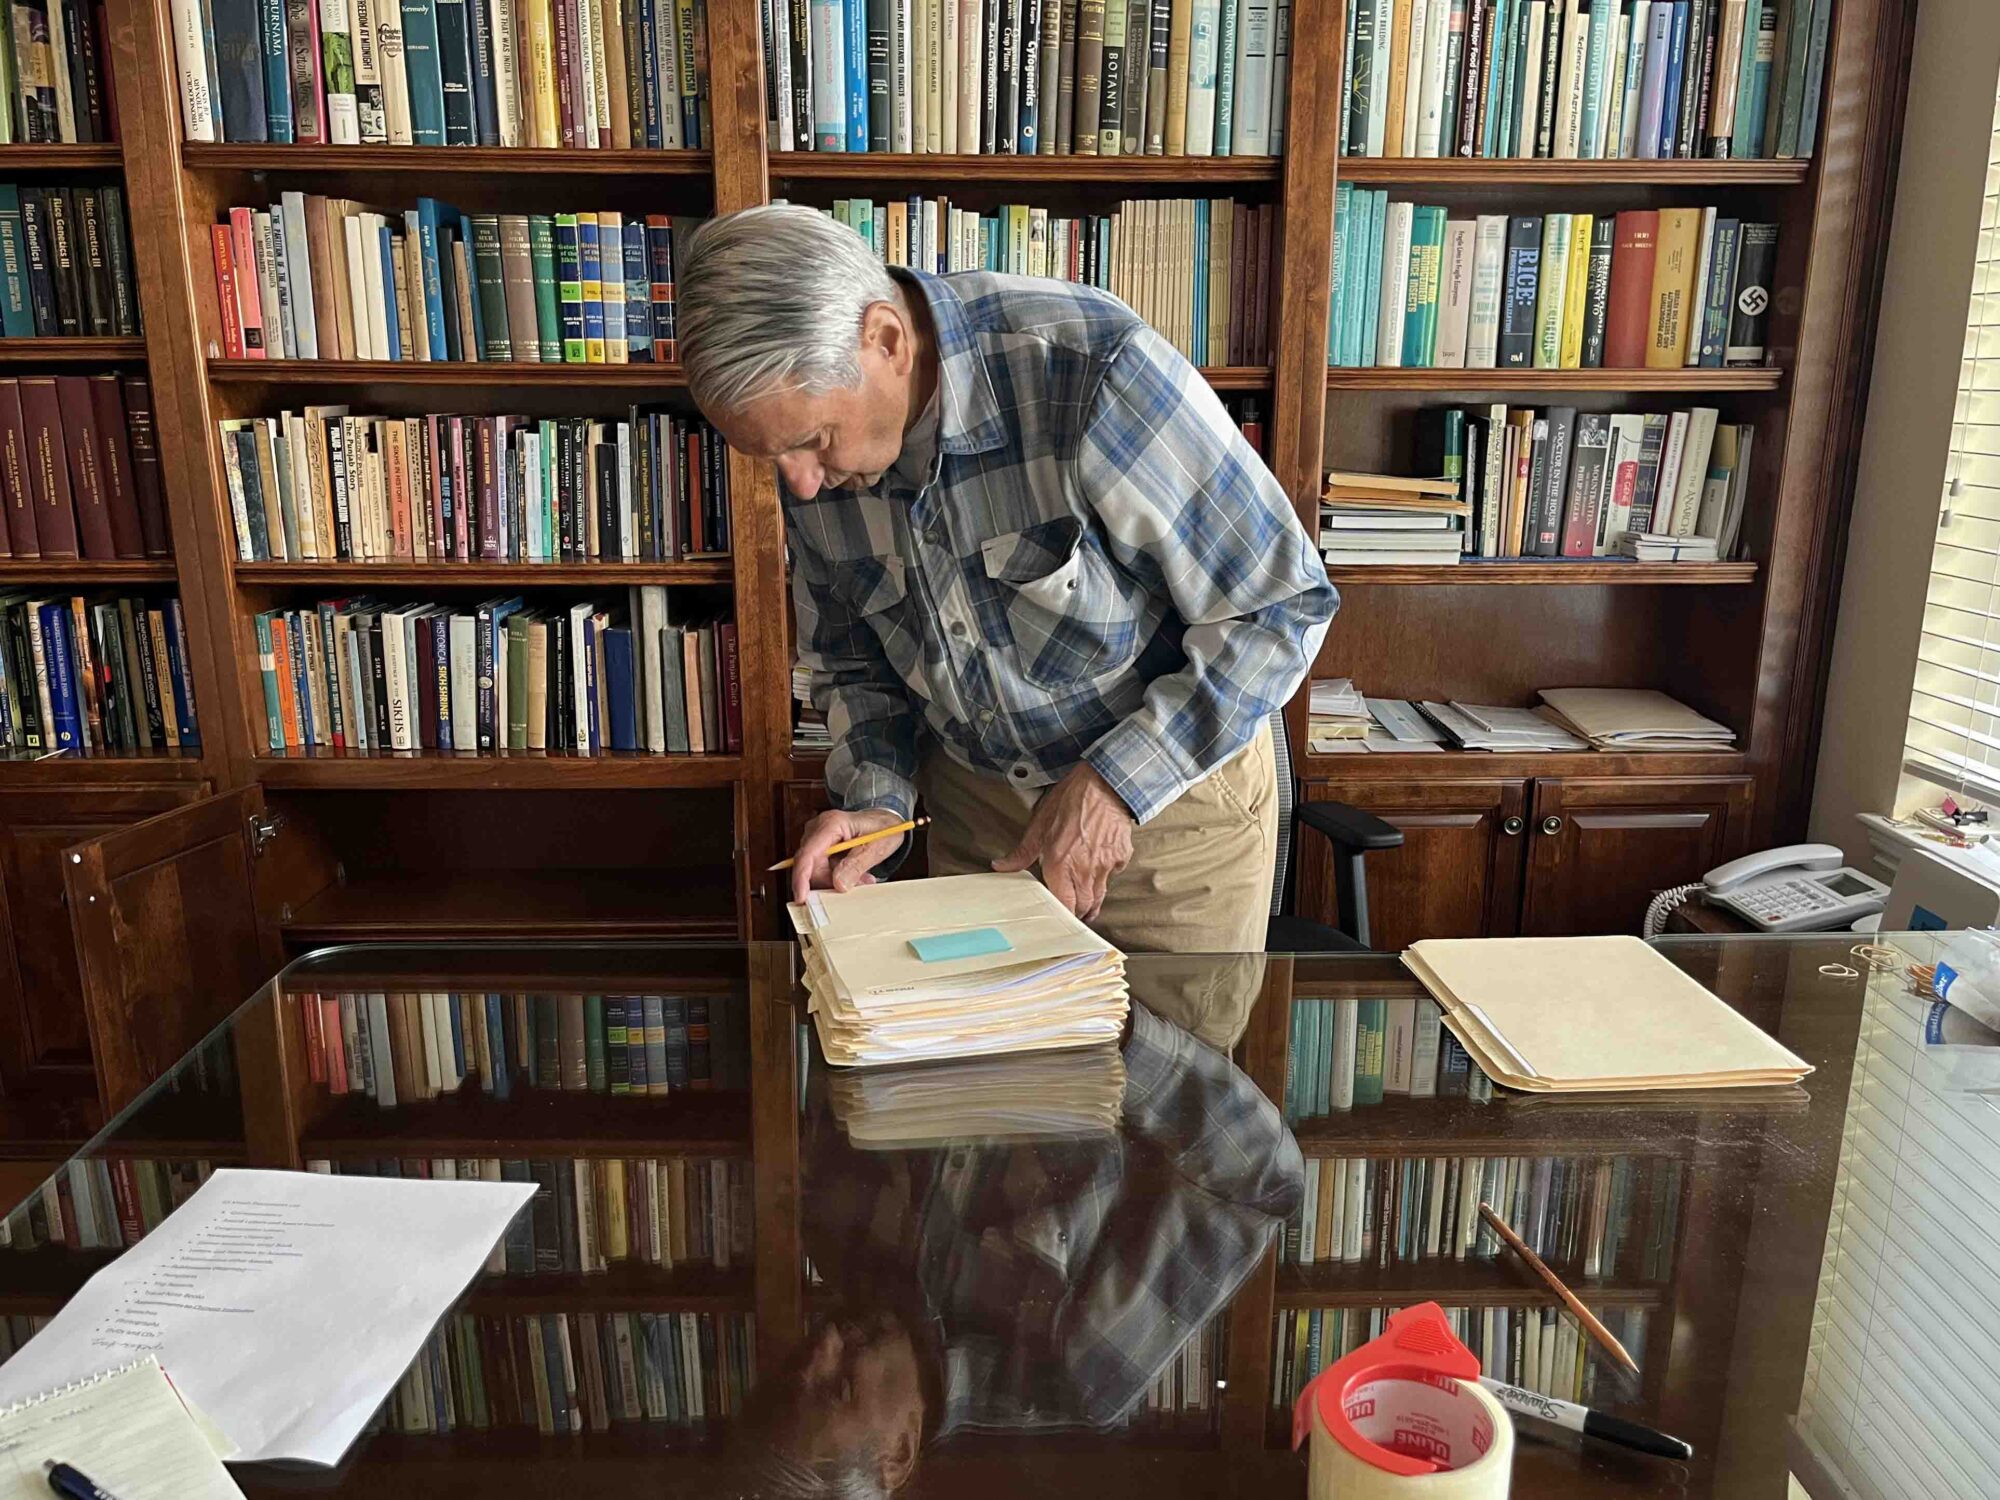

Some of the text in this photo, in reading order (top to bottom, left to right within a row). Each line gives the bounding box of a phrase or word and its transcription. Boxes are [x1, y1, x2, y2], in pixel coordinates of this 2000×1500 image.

[502, 37, 510, 52] WAS
[681, 8, 696, 91] SIKH SEPARATISM
[1003, 27, 1012, 71] Crop Plants
[1197, 11, 1212, 85] GENETICS
[1378, 20, 1387, 50] BREEDING
[1470, 23, 1480, 45] Major
[361, 38, 373, 70] MIDNIGHT
[503, 55, 511, 73] INDIA
[591, 5, 601, 46] GENERAL
[598, 99, 607, 127] SINGH
[1220, 5, 1235, 127] GROWING RICE PLANT
[1445, 36, 1458, 96] Plant Breeding
[1469, 47, 1478, 68] Food
[1704, 36, 1714, 73] BEYOND
[1025, 41, 1036, 106] Cytogenetics
[1106, 53, 1118, 109] BOTANY
[1466, 69, 1476, 99] Staples
[1343, 91, 1353, 109] Plant
[1569, 93, 1579, 148] Agriculture
[25, 203, 35, 222] Rice
[272, 214, 280, 224] THE
[1, 221, 17, 273] RICE GENETICS
[28, 224, 40, 261] Genetics
[53, 198, 70, 267] Rice Genetics III
[85, 198, 101, 267] Rice Genetics III
[274, 229, 284, 257] PARTITION
[1457, 230, 1465, 246] Fragile
[278, 273, 286, 282] THE
[1410, 258, 1419, 277] RICE
[1453, 264, 1462, 280] Fragile
[1516, 250, 1538, 306] RICE:
[280, 286, 288, 306] PUNJAB
[1407, 279, 1419, 312] INSECTS
[391, 430, 399, 444] THE
[1552, 431, 1564, 467] DOCTOR
[345, 422, 356, 492] The Punjab Story
[392, 445, 400, 465] SIKHS
[1550, 480, 1559, 497] THE
[1553, 469, 1560, 479] IN
[1622, 464, 1635, 504] THE GENE
[441, 477, 451, 518] BLUE STAR
[1572, 466, 1585, 522] PHILIP ZIEGLER
[1586, 464, 1599, 525] MOUNTBATTEN
[1547, 499, 1557, 528] HOUSE
[1677, 490, 1696, 536] ANARCHY
[374, 657, 382, 678] SIKHS
[436, 622, 448, 720] HISTORICAL SIKH SHRINES
[392, 699, 405, 733] SIKHS
[1506, 1388, 1566, 1419] Sharpie
[1395, 1431, 1449, 1457] ULINE
